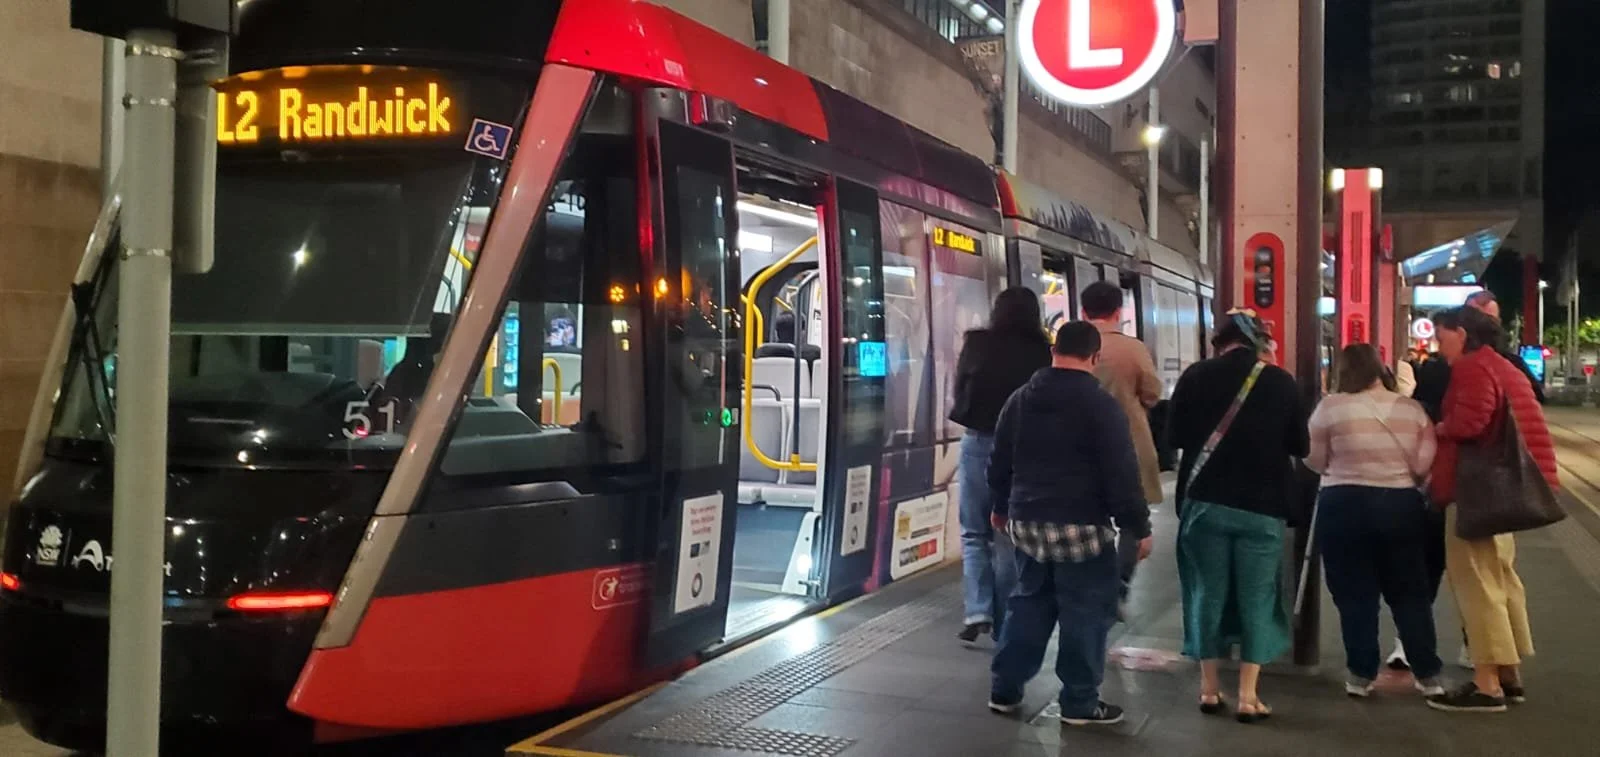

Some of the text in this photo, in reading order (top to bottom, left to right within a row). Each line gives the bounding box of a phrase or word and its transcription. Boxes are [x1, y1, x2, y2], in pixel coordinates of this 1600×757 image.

[1069, 0, 1123, 69] L
[216, 83, 451, 142] L2 Randwick
